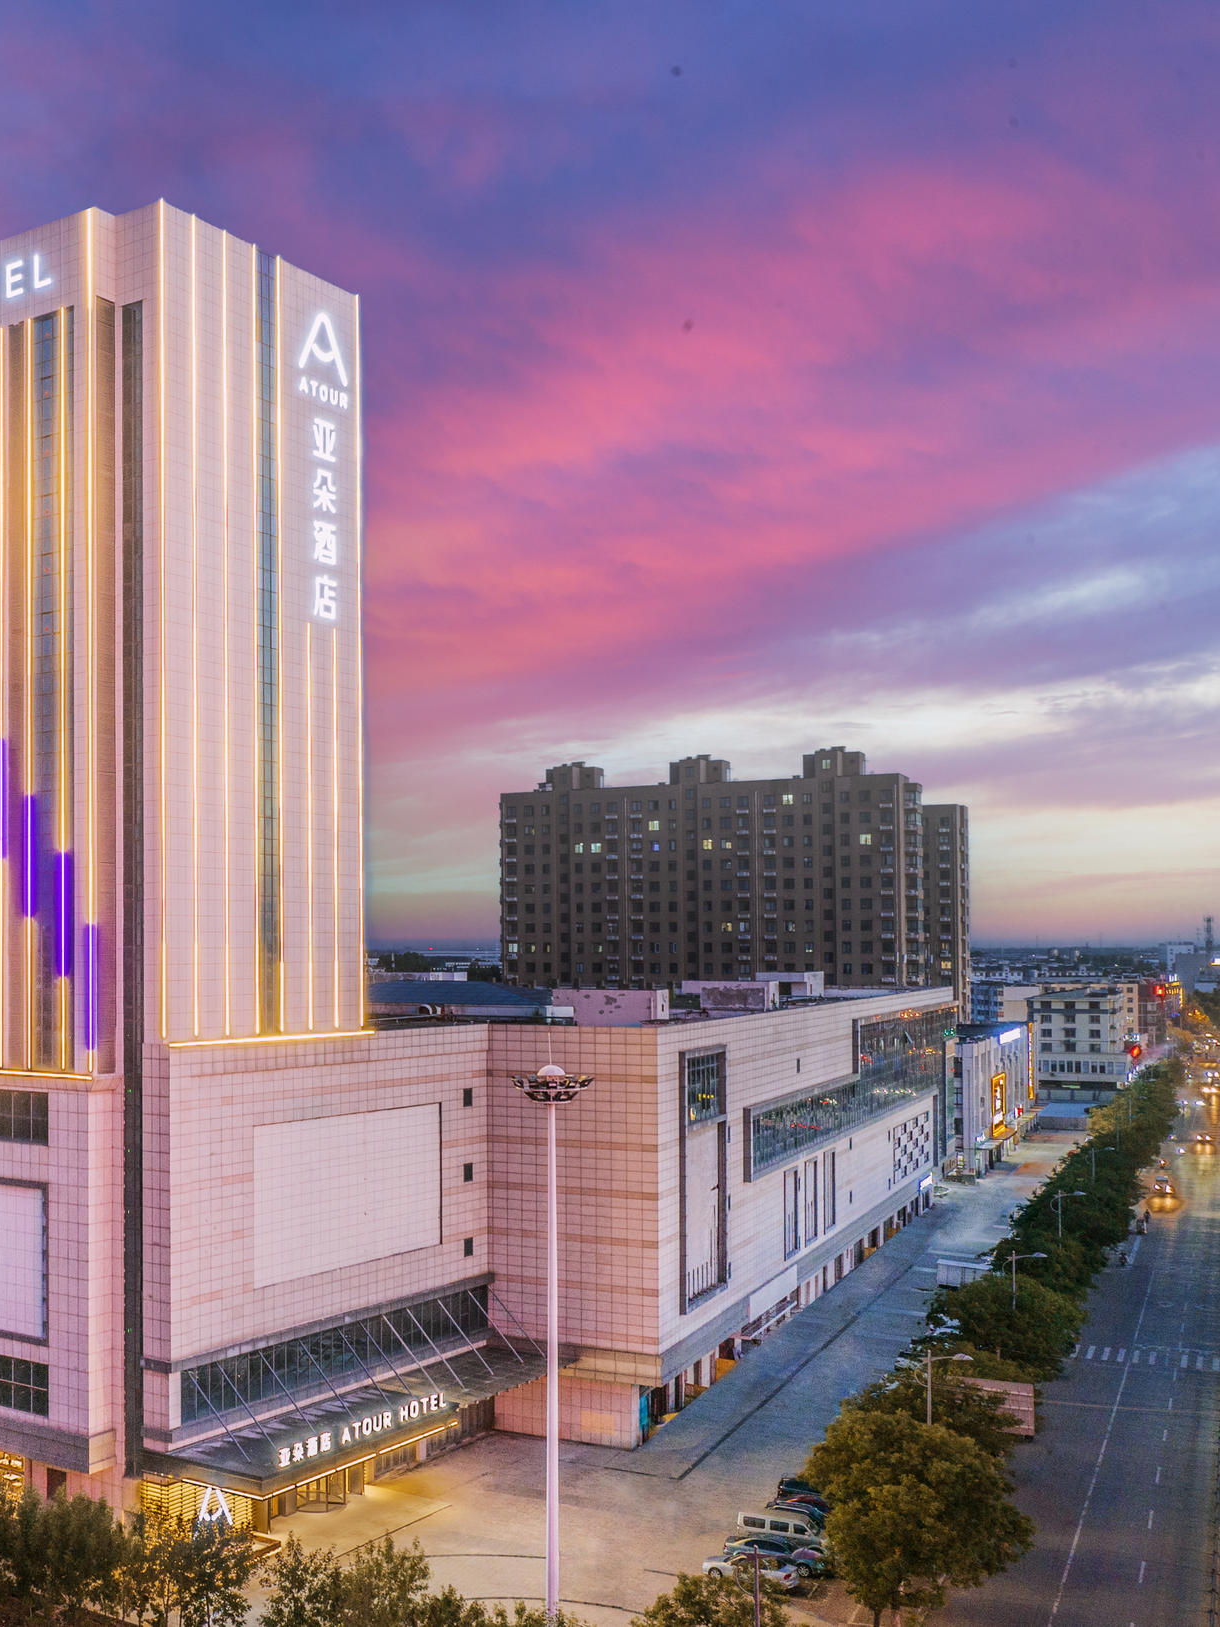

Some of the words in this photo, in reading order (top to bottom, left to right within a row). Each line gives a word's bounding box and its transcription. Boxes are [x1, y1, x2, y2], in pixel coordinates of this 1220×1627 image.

[299, 376, 348, 410] ATOUR
[313, 417, 337, 620] 亚朵酒店
[341, 1410, 392, 1445] ATOUR
[399, 1392, 447, 1422] HOTEL
